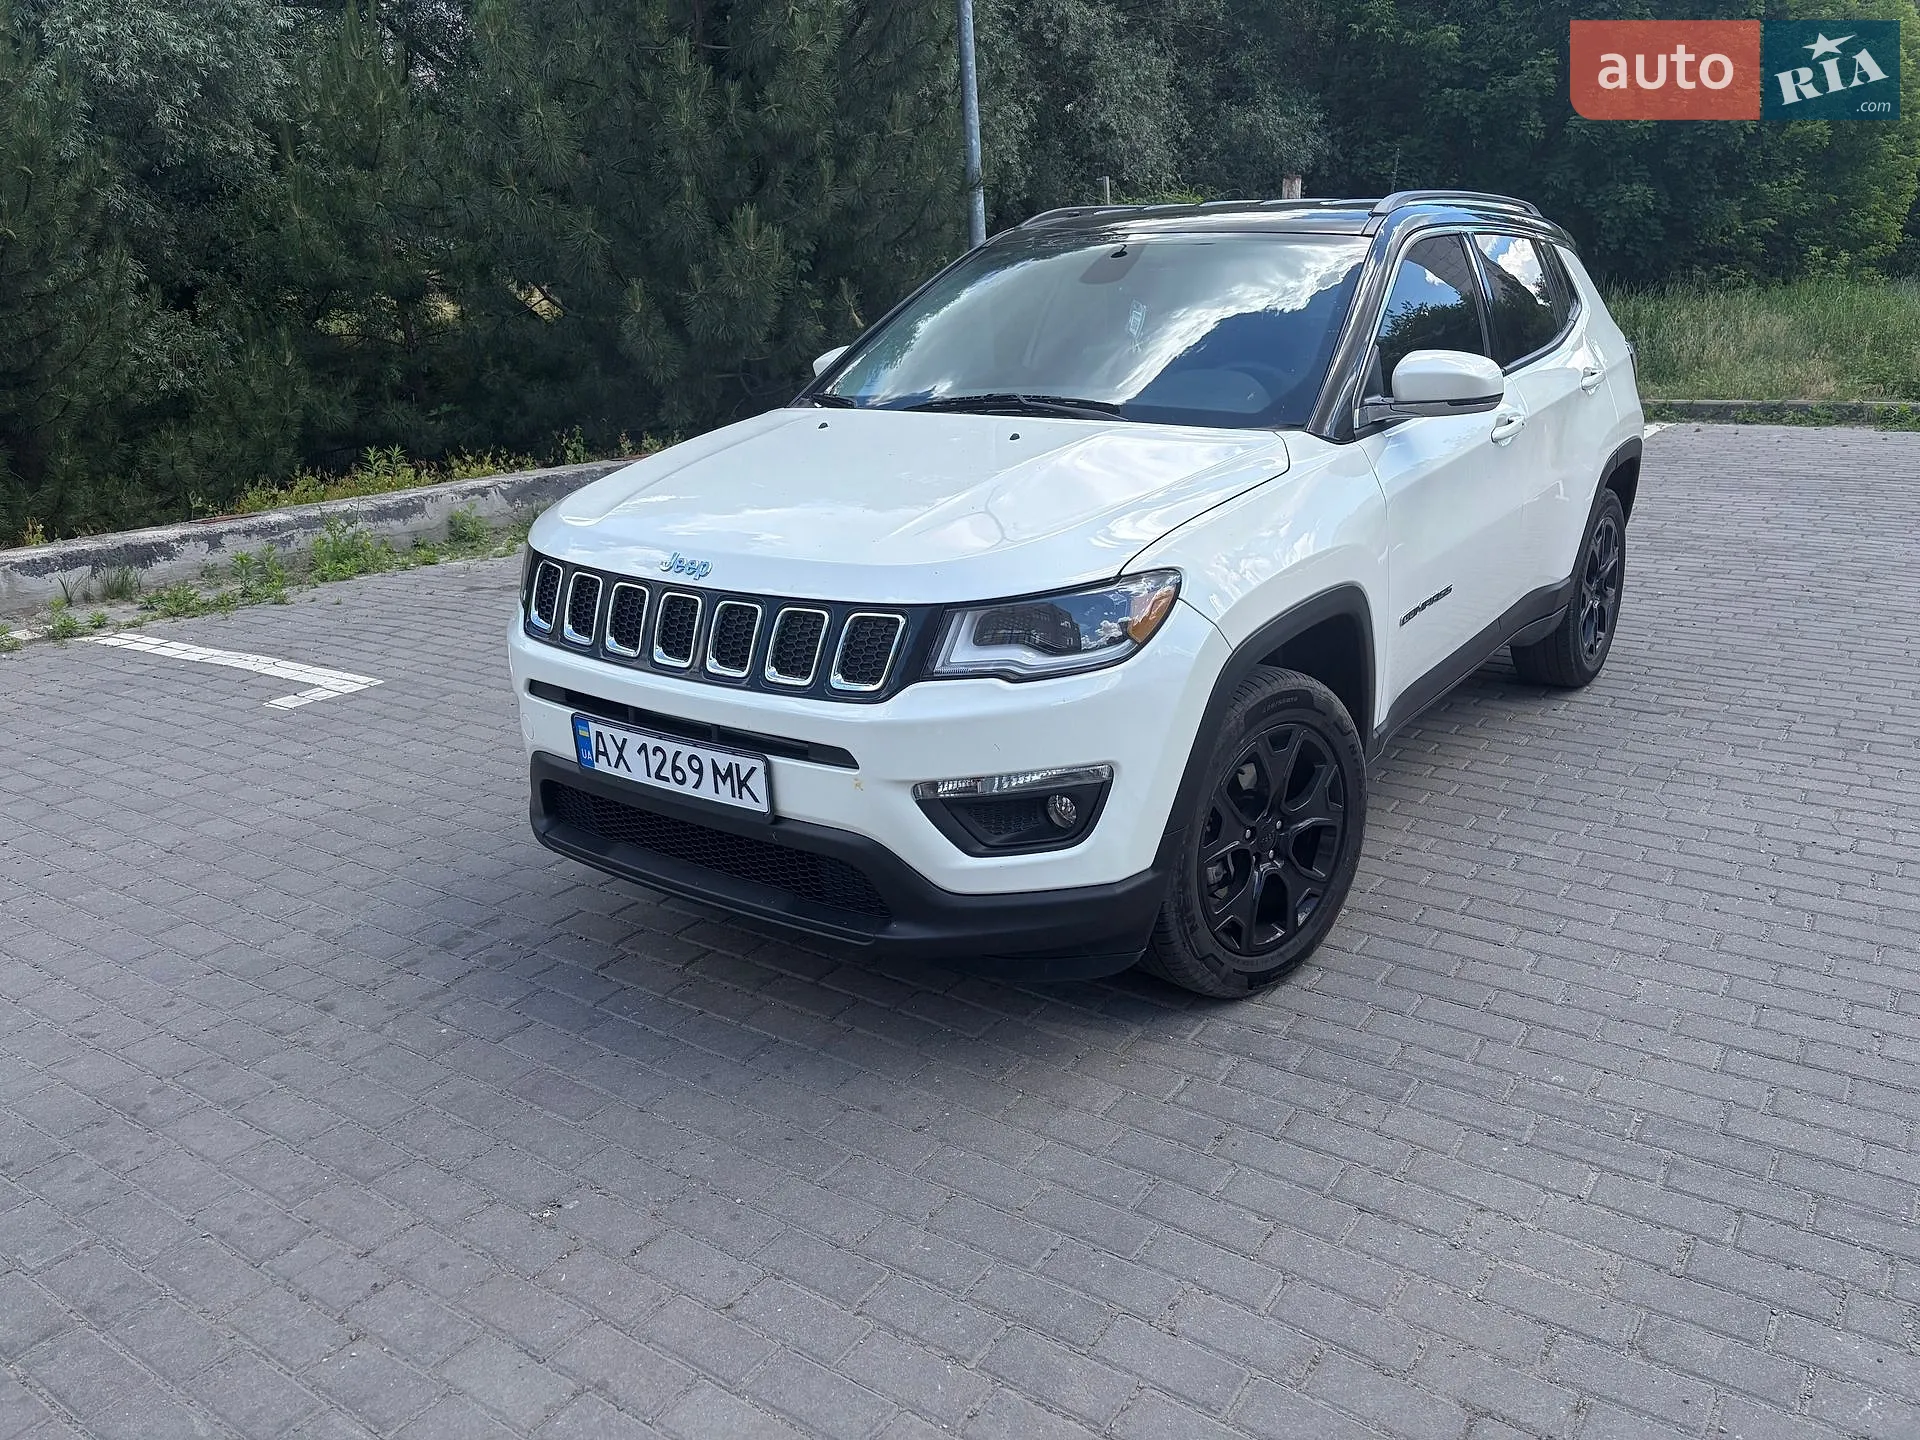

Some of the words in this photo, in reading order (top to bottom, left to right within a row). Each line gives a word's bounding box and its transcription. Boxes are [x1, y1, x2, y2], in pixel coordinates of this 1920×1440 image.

[660, 552, 712, 580] Jeep
[581, 748, 593, 761] UA
[595, 730, 632, 773] AX
[637, 743, 704, 790] 1269
[711, 757, 760, 804] MK
